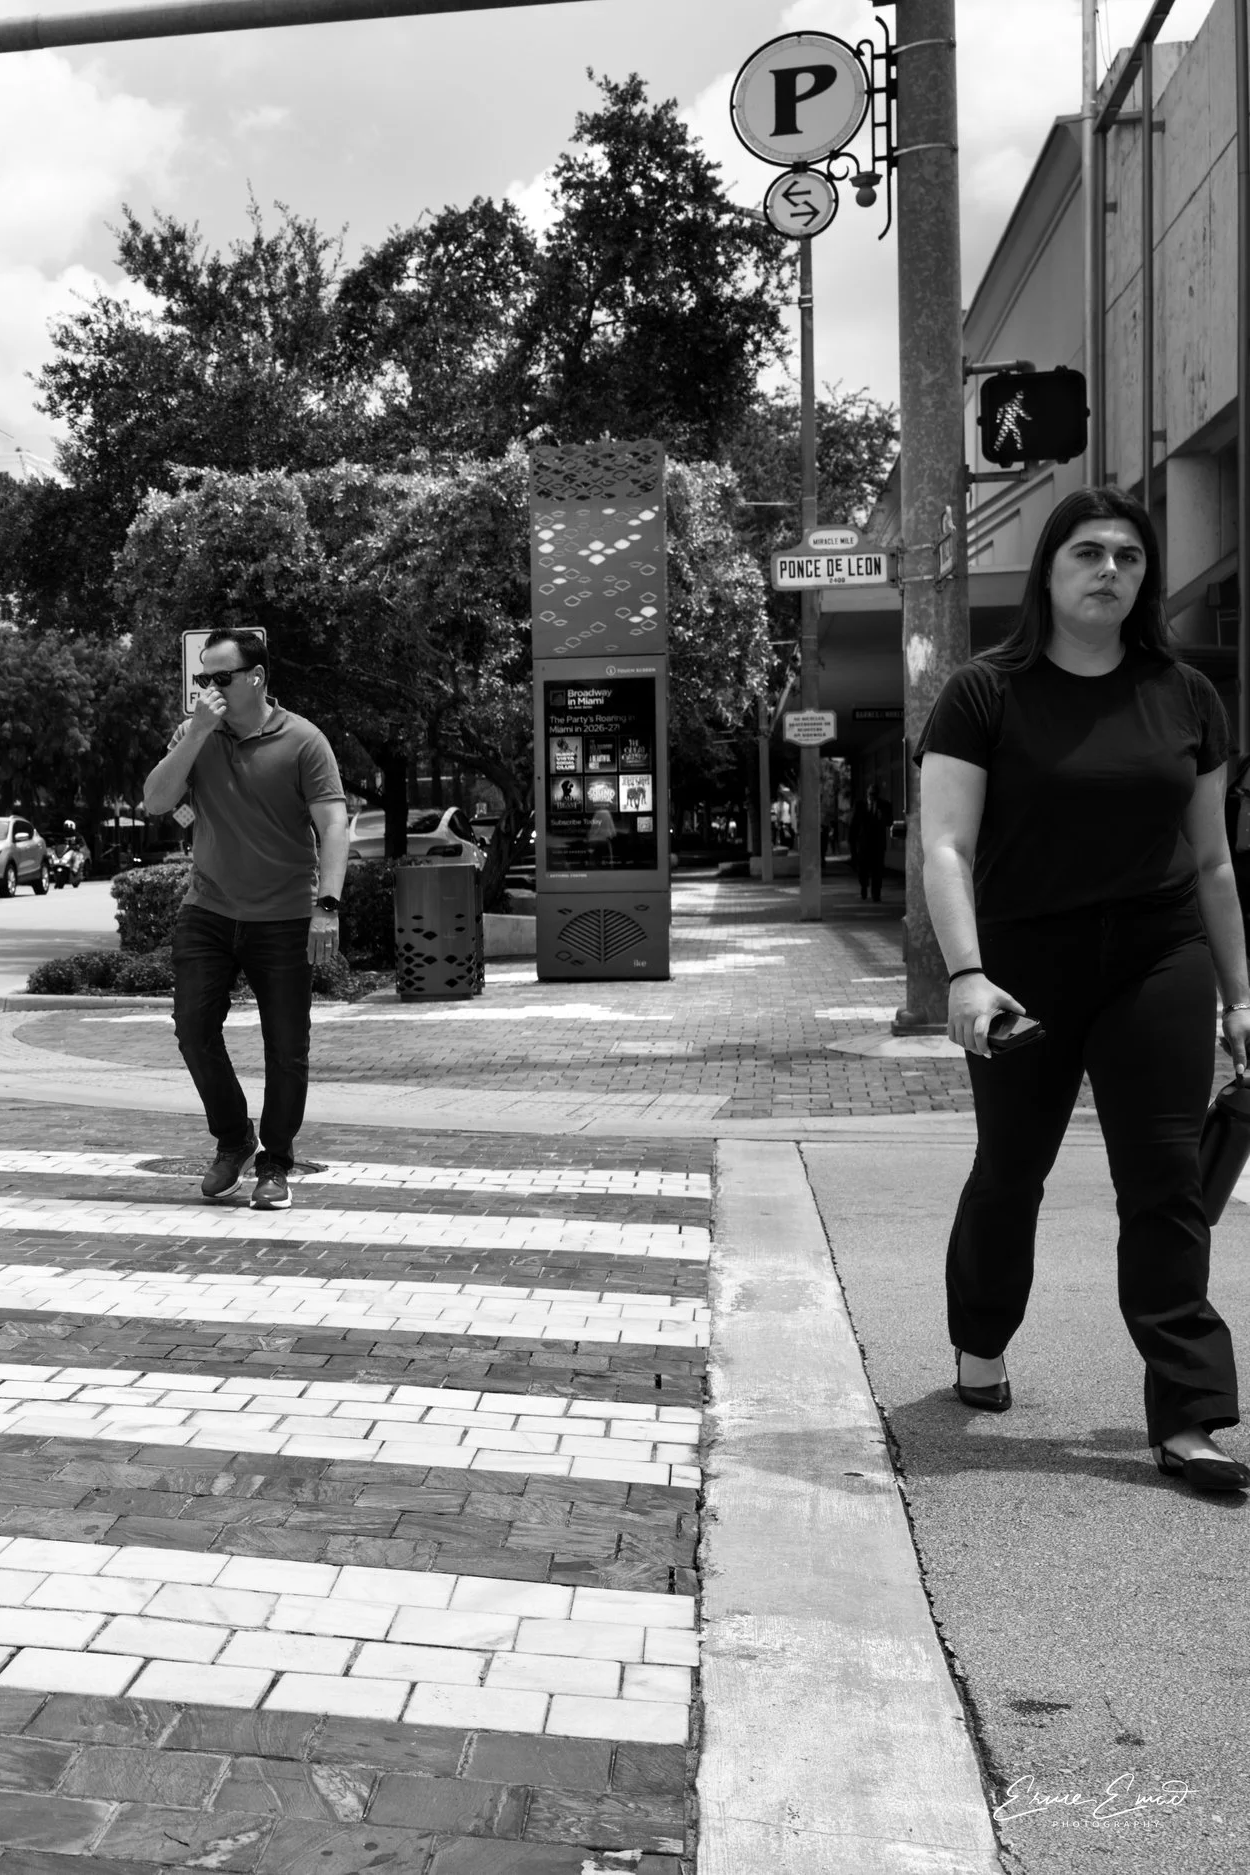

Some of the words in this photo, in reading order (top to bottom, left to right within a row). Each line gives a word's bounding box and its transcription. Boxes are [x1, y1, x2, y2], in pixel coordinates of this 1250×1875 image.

[769, 64, 837, 137] P
[813, 538, 838, 546] MIRACLE
[840, 536, 854, 545] MILE
[779, 559, 822, 579] PONCE
[848, 556, 882, 576] LEON
[567, 688, 613, 698] Broadway
[567, 697, 576, 706] in
[577, 696, 605, 706] Miami
[550, 715, 565, 724] The
[566, 715, 594, 725] Party's
[549, 725, 573, 734] Miami
[575, 725, 582, 733] in
[550, 818, 582, 826] Subscribe
[583, 818, 602, 826] Today
